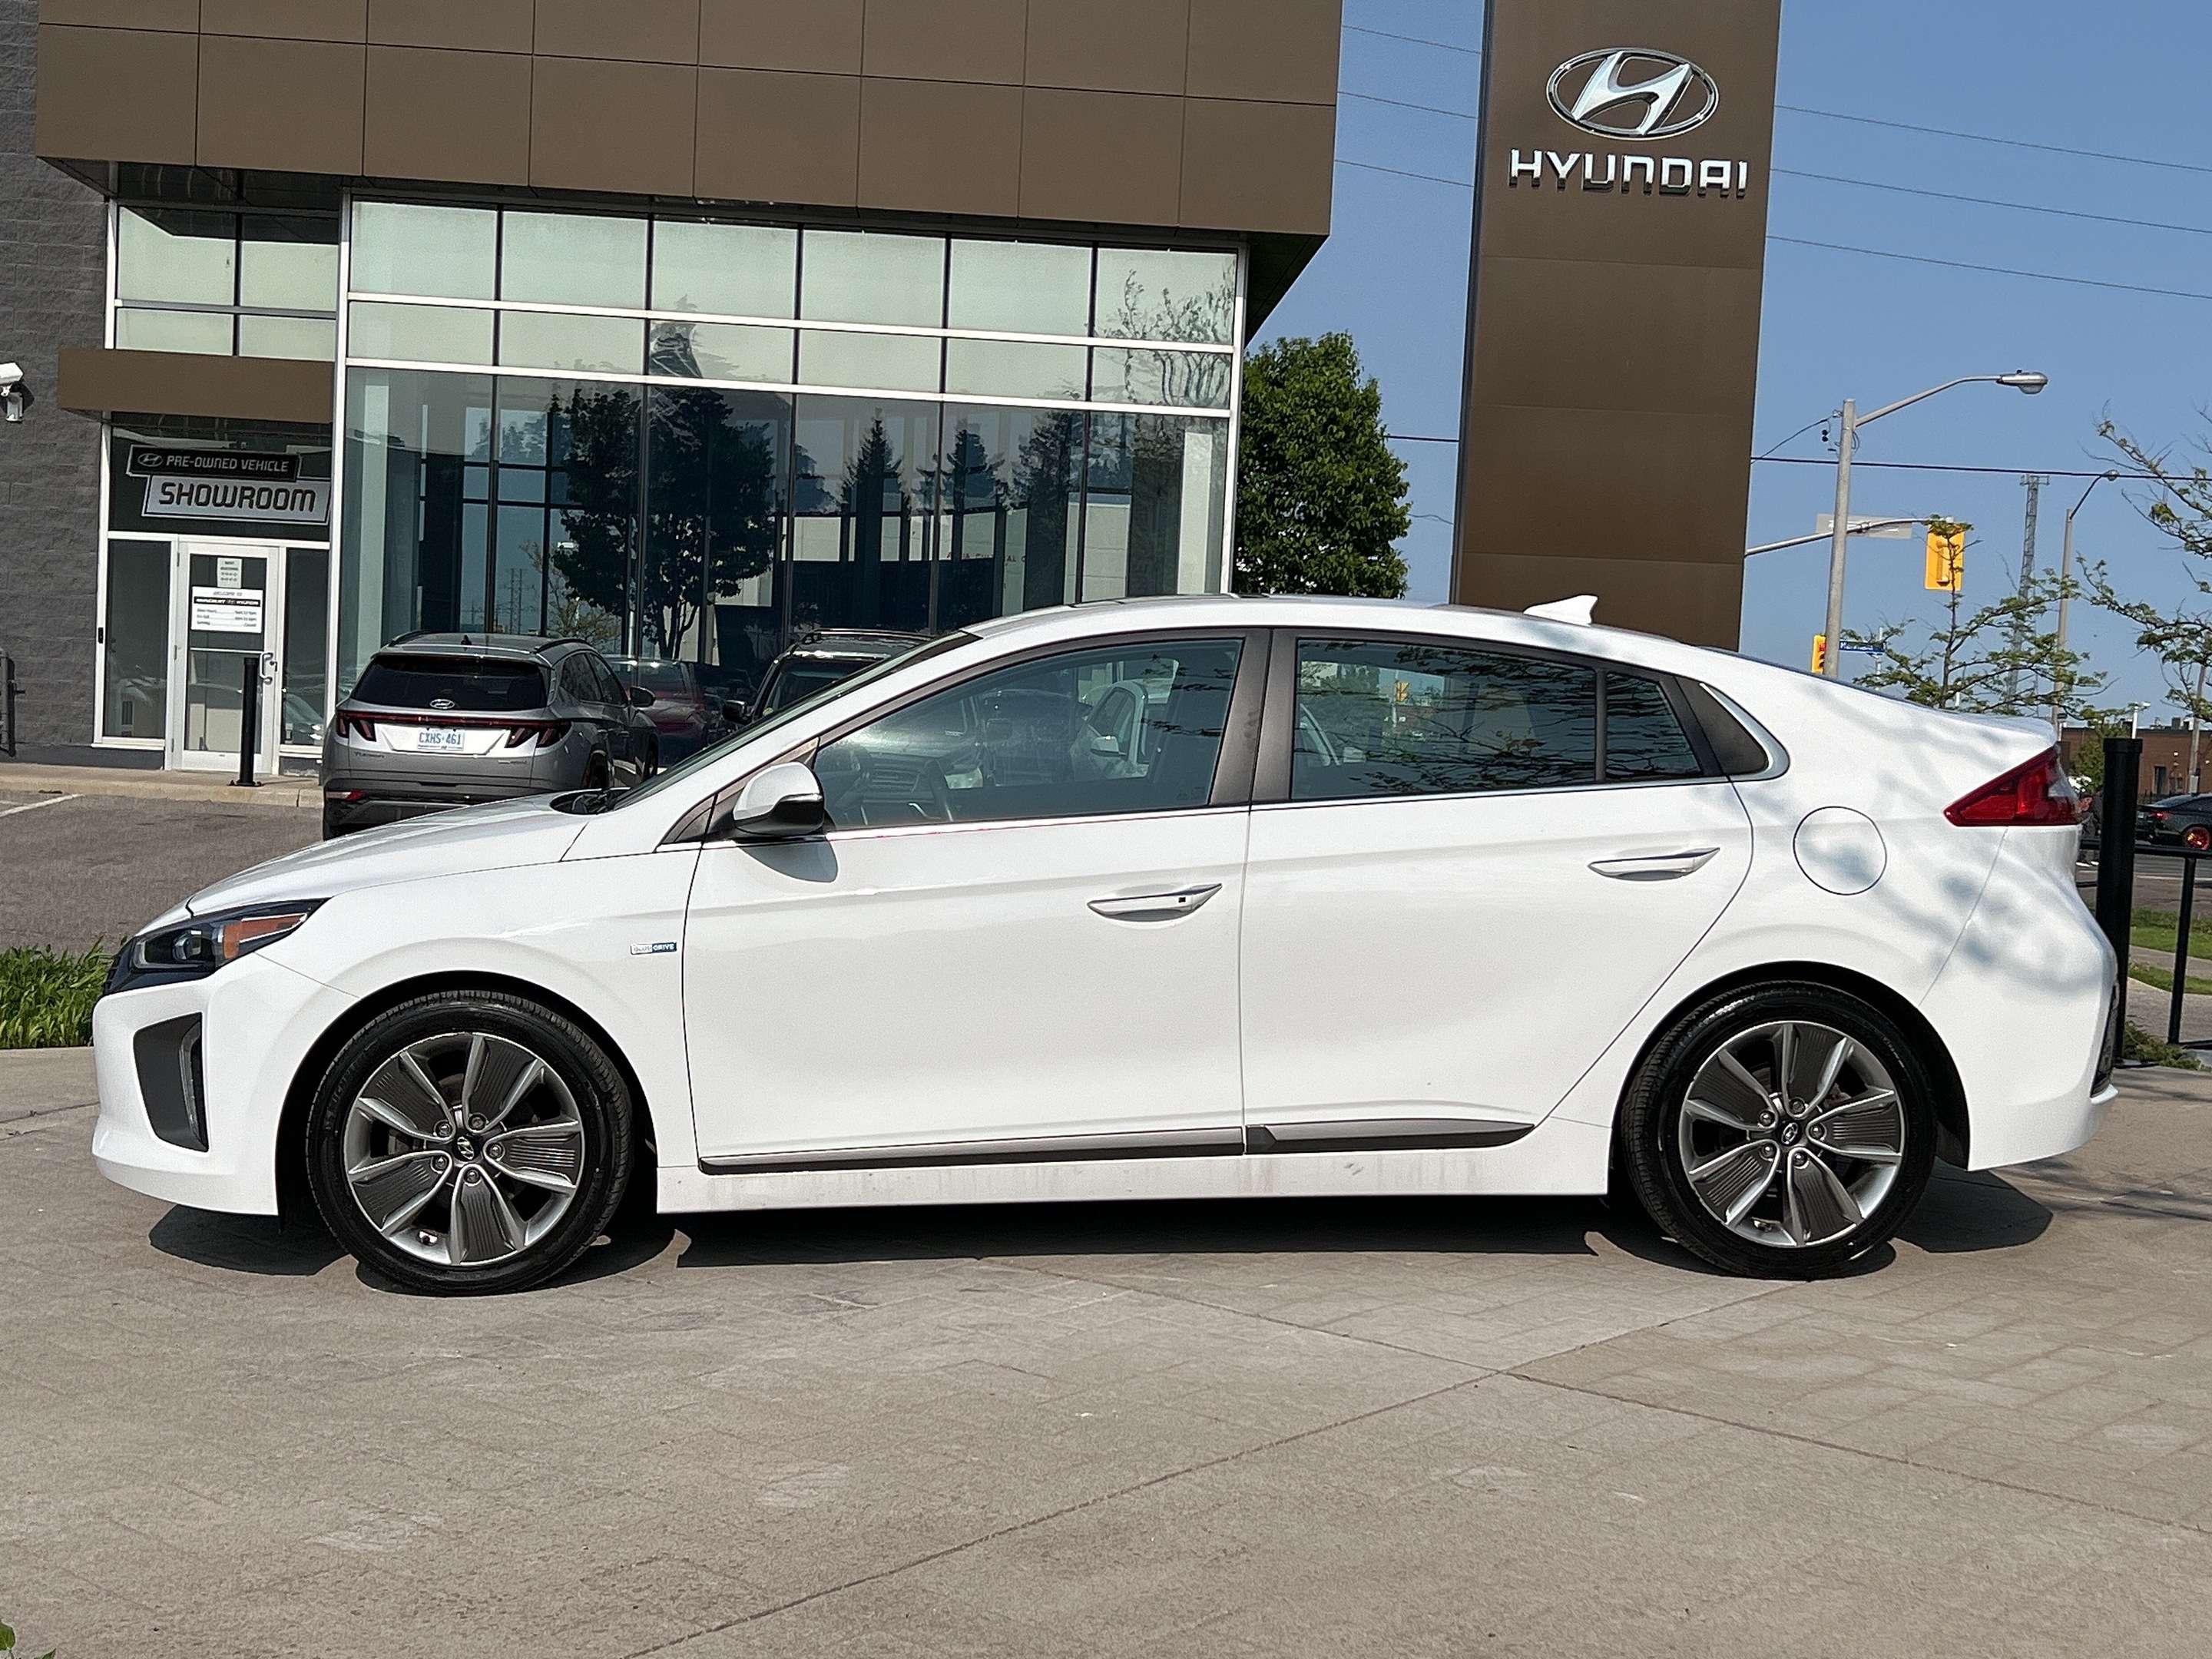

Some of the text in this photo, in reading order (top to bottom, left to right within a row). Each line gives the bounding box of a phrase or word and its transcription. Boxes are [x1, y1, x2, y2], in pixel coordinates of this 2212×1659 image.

[1509, 148, 1749, 197] HYUNDAI
[166, 455, 290, 472] PRE-OWNED VEHICLE
[158, 481, 316, 513] SHOWROOM
[445, 733, 462, 745] 461
